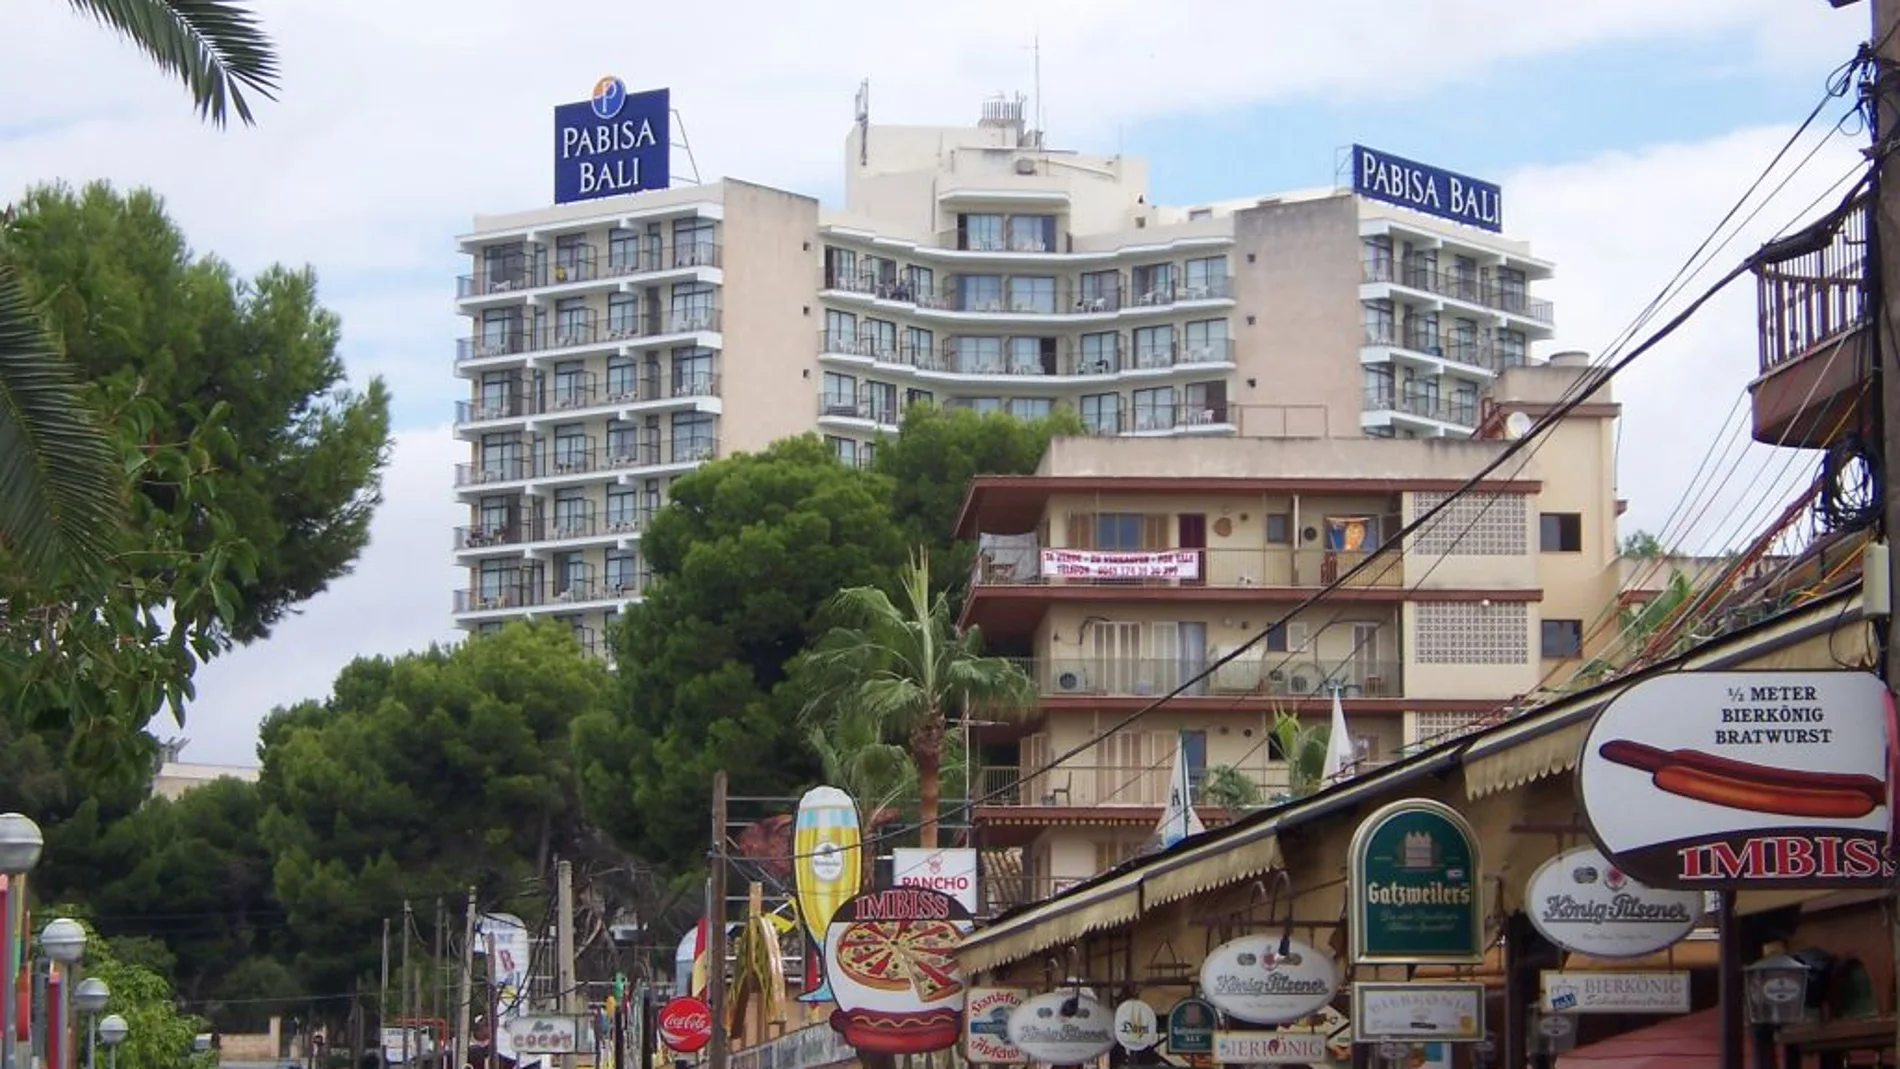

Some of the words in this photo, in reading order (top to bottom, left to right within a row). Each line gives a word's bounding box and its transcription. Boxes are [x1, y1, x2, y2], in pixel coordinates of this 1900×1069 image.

[563, 118, 656, 158] PABISA
[579, 157, 639, 193] BALI
[1362, 151, 1440, 208] PABISA
[1450, 177, 1500, 224] BALI
[1750, 686, 1818, 701] METER
[1721, 705, 1824, 723] BIERKÖNIG
[1715, 728, 1832, 744] BRATWURST
[855, 889, 949, 919] IMBISS
[1368, 881, 1470, 906] Gatzweilers
